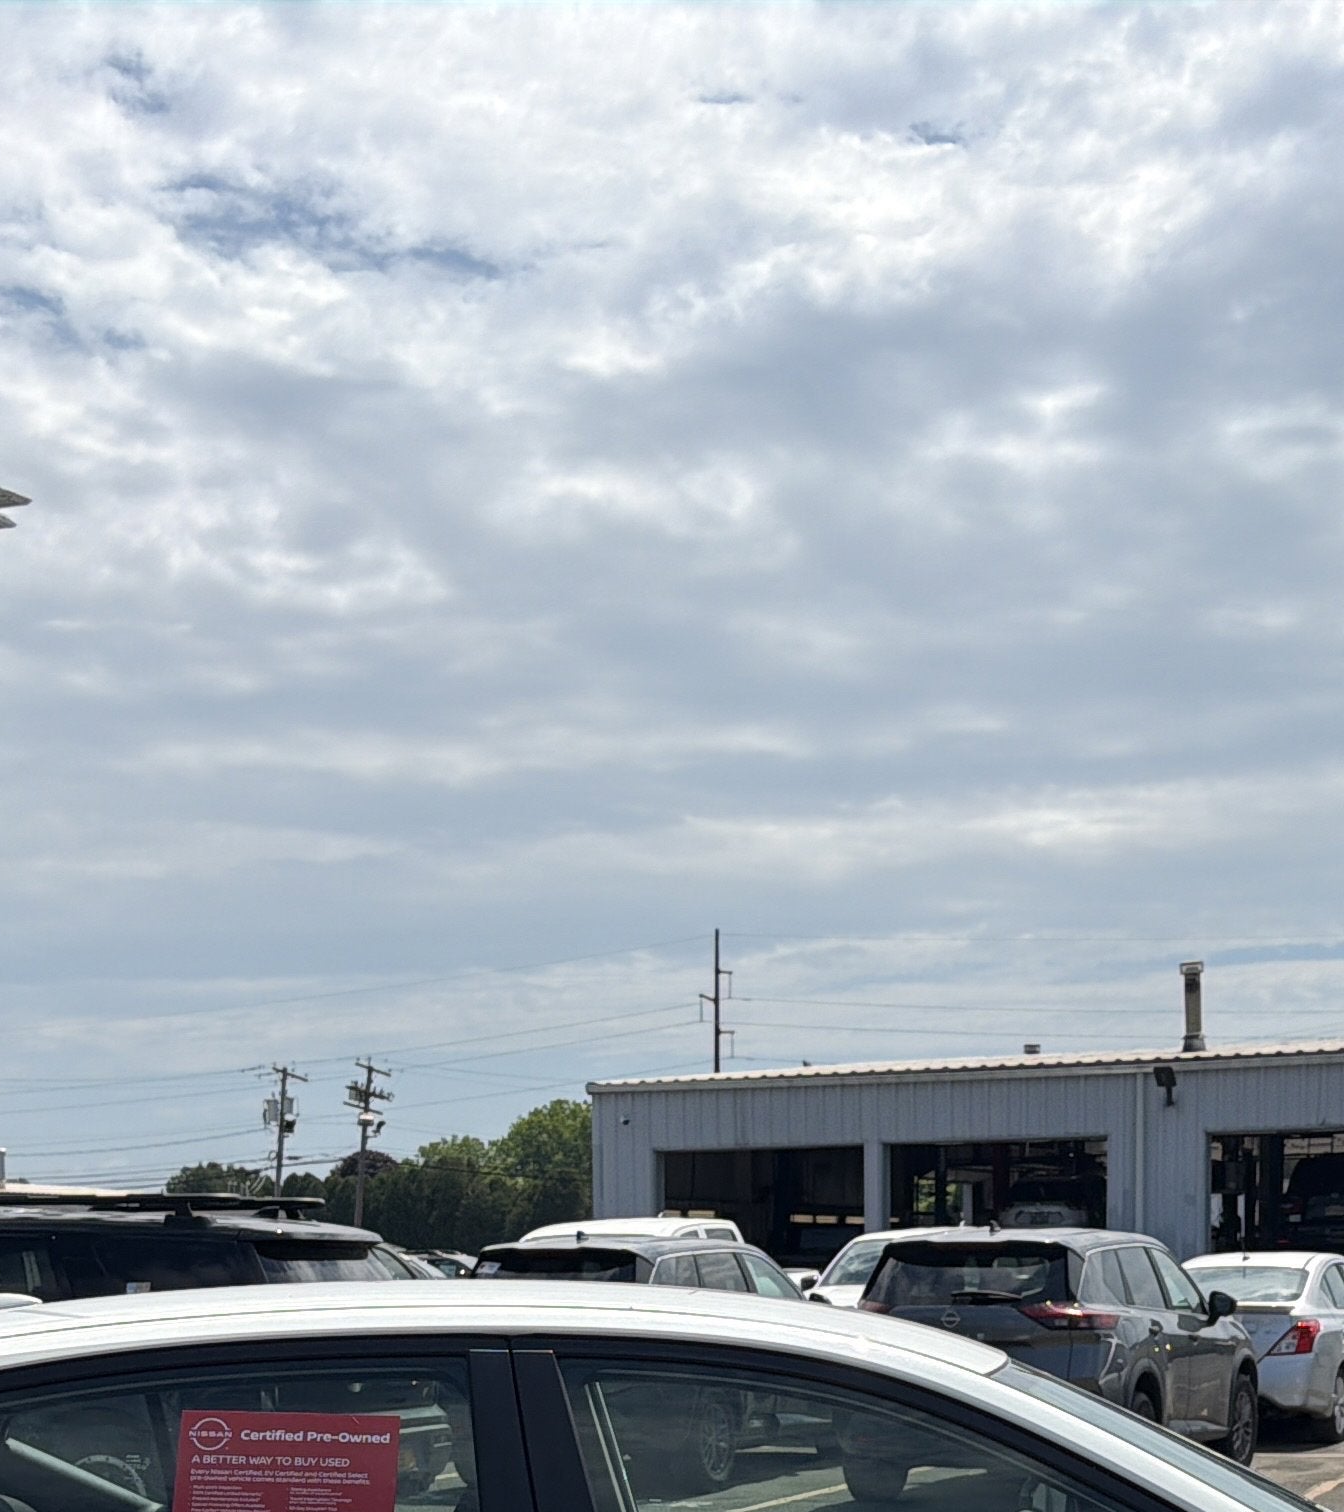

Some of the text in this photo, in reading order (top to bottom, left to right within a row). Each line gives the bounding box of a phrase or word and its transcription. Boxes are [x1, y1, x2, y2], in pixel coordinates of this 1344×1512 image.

[189, 1430, 232, 1438] NISSAN
[240, 1429, 390, 1444] Certified Pre-Owned
[191, 1455, 350, 1467] A BETTER WAY TO BUY USED
